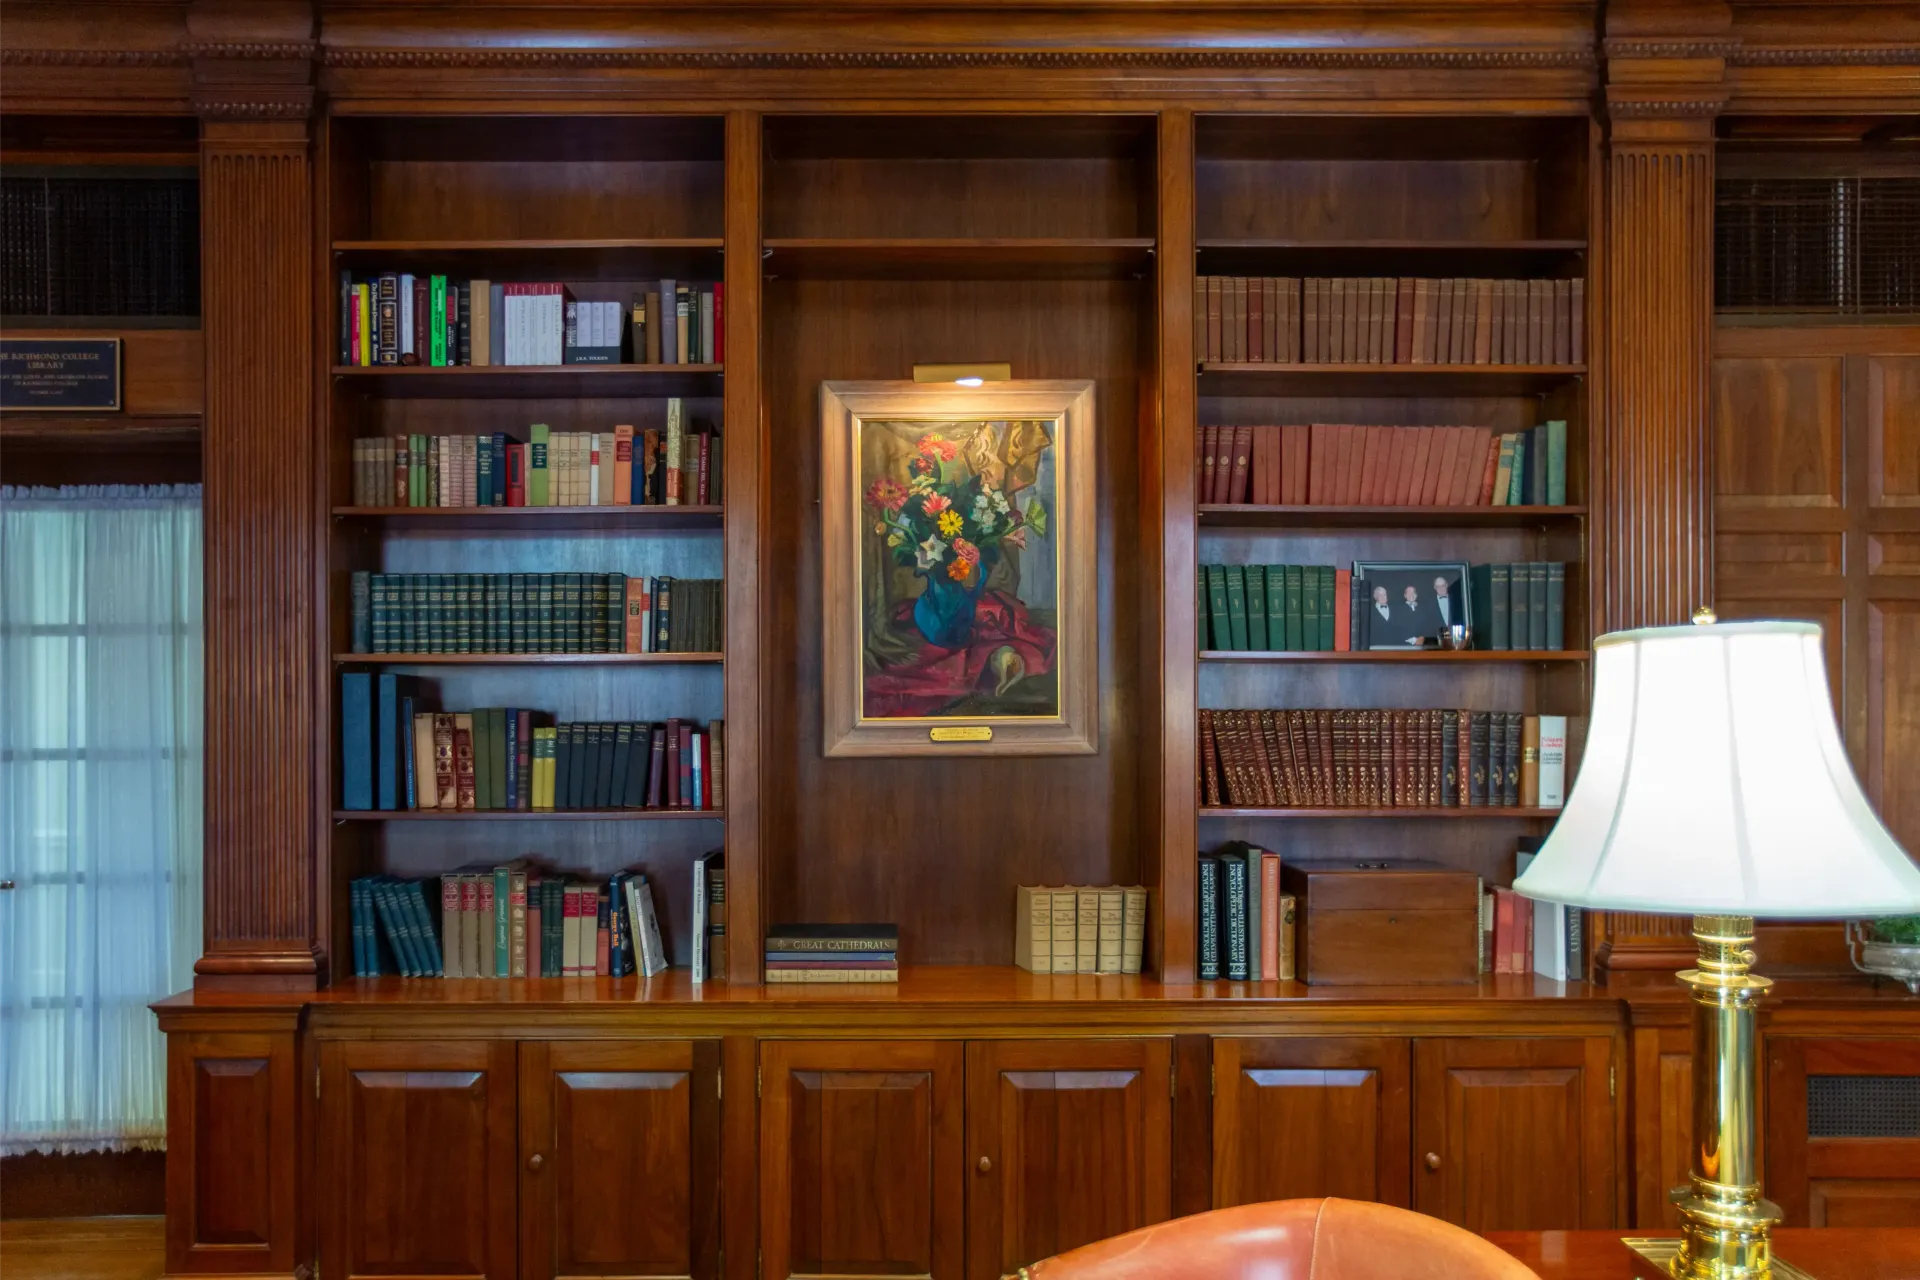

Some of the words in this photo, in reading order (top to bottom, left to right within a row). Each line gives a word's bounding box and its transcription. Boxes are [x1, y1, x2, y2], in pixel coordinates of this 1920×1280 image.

[12, 352, 60, 360] RICHMOND
[1207, 890, 1216, 910] Digest
[1235, 890, 1244, 910] Digest
[793, 940, 824, 950] GREAT
[827, 940, 890, 950] CATHEDRALS
